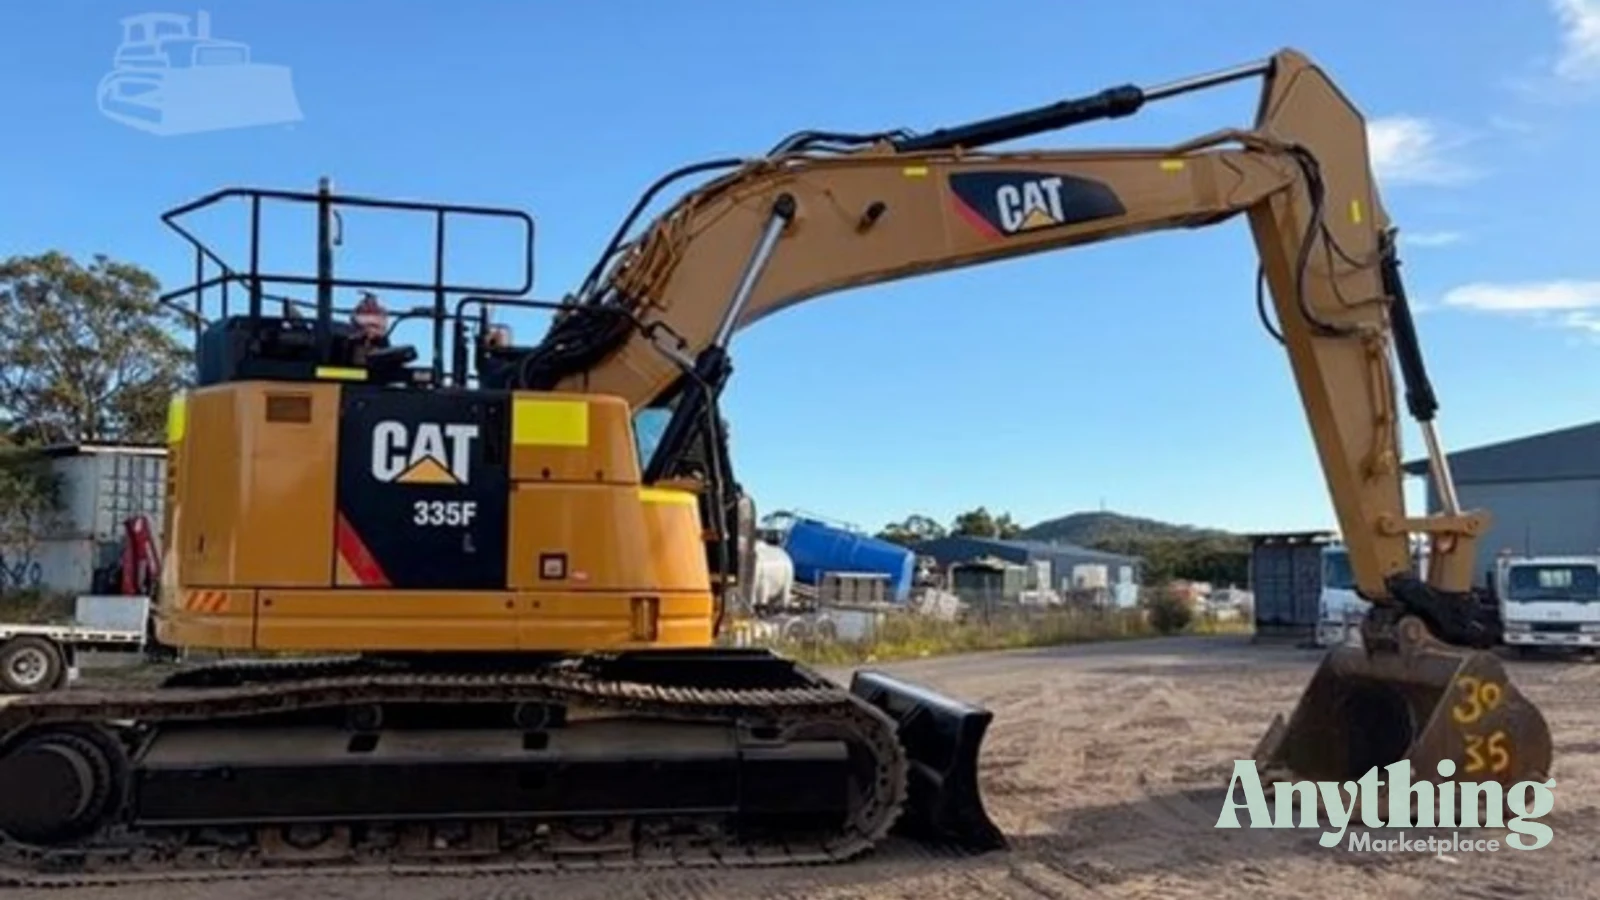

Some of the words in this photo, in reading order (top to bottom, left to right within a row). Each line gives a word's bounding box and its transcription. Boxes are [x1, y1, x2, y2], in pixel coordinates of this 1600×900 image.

[996, 177, 1065, 232] CAT
[372, 420, 479, 484] CAT
[414, 501, 477, 526] 335F
[1464, 731, 1509, 772] 35
